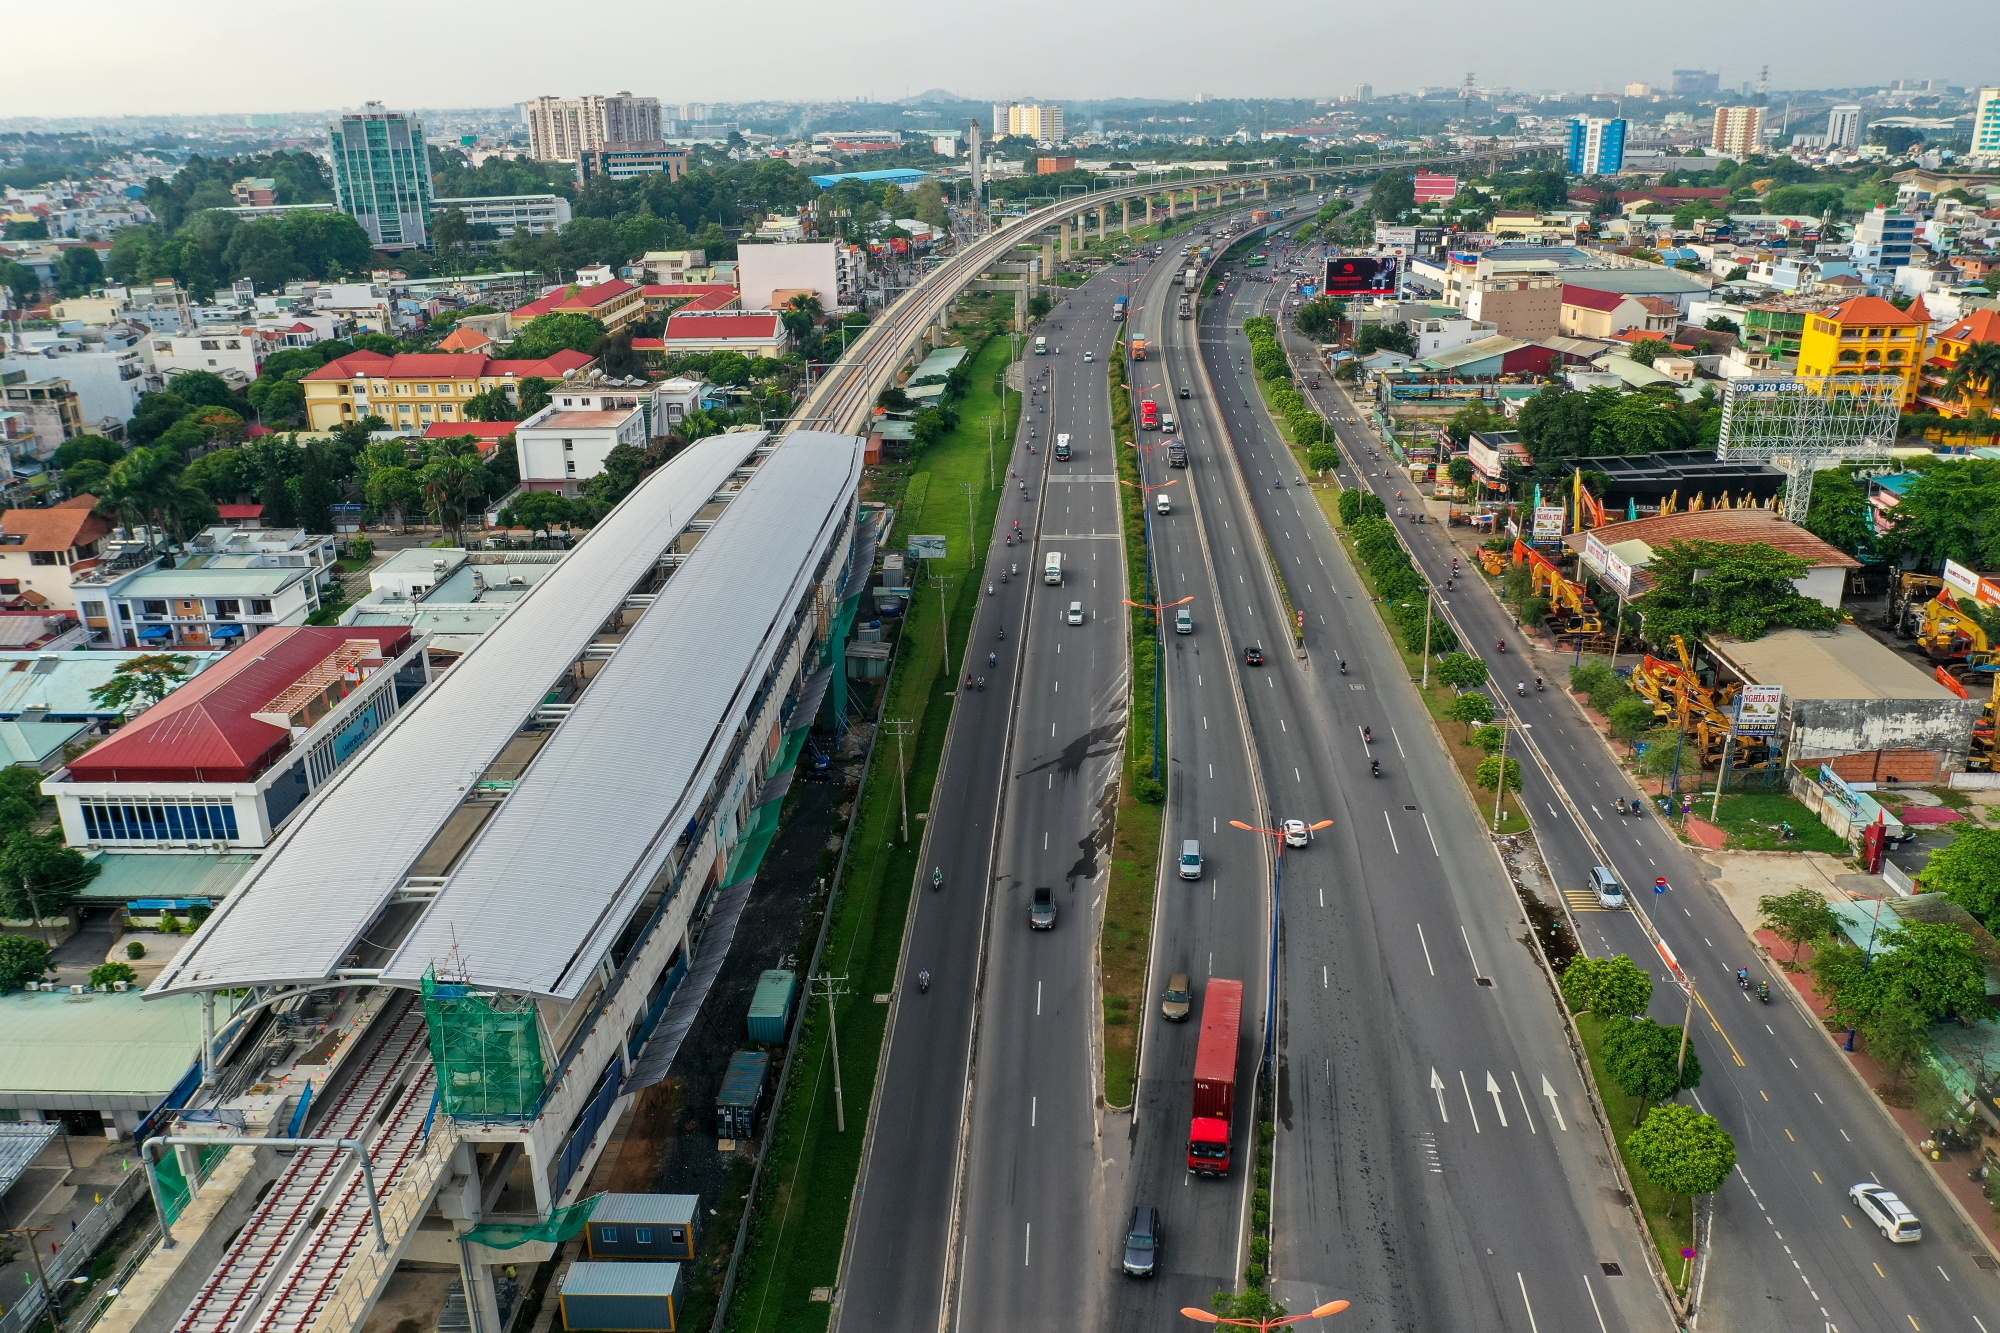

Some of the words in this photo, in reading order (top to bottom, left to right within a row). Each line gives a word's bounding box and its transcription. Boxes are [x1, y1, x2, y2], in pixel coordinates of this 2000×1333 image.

[1736, 383, 1755, 392] 090
[1757, 383, 1777, 392] 370
[1779, 382, 1804, 391] 8596
[1743, 693, 1765, 702] NGHĨA
[1767, 693, 1779, 702] TRÍ
